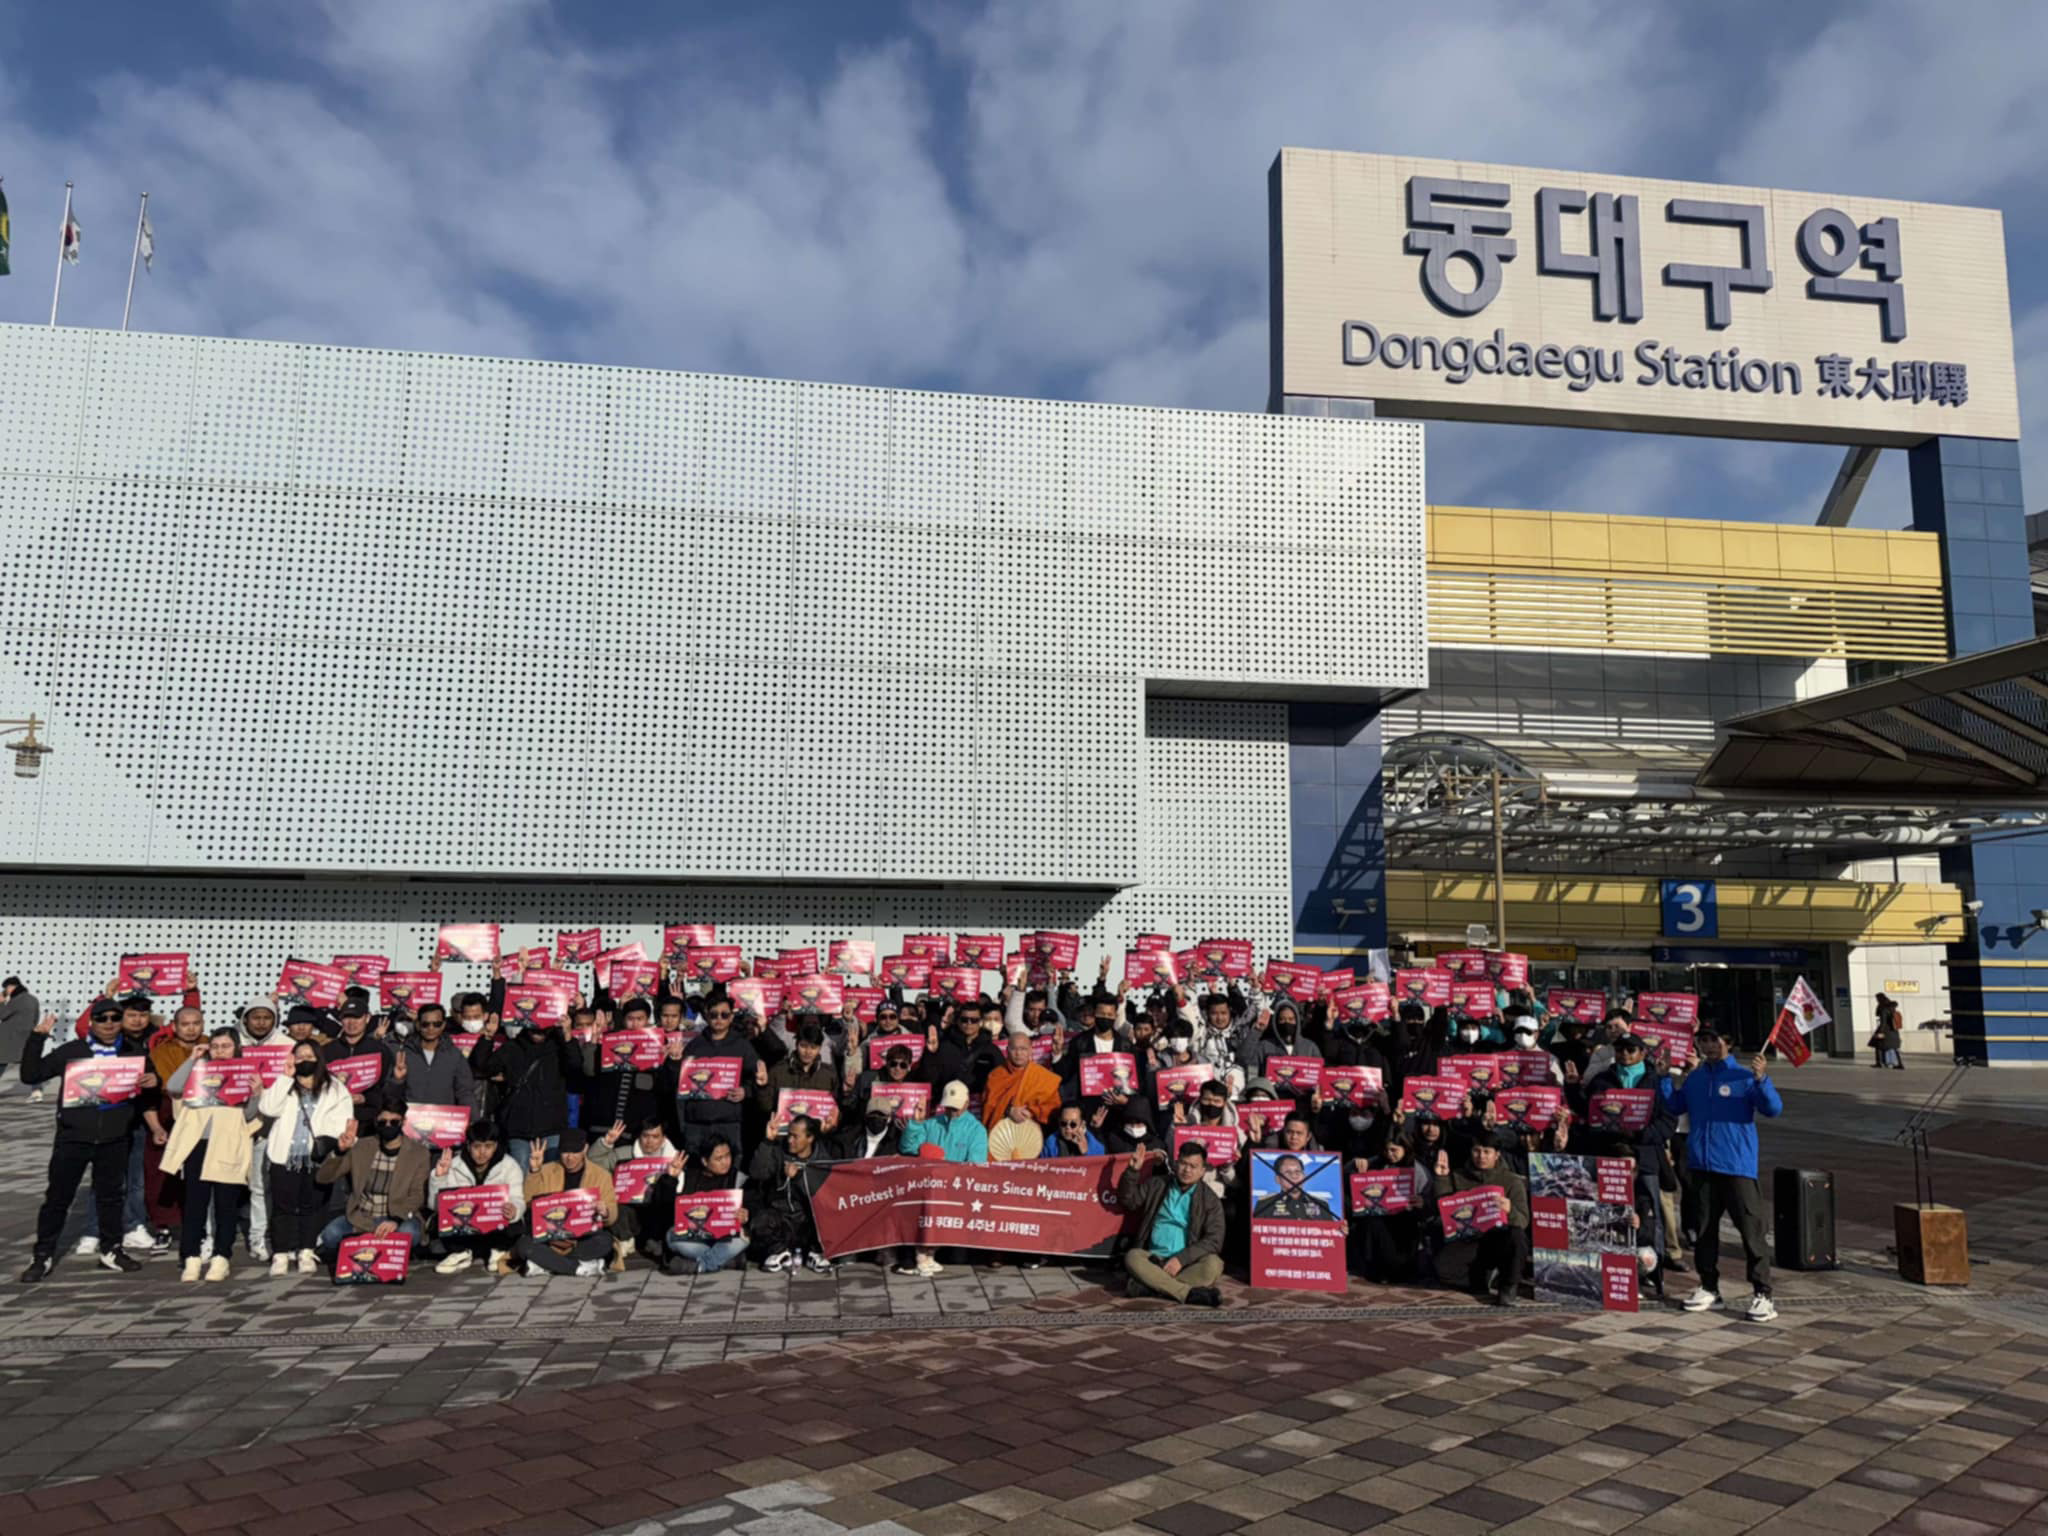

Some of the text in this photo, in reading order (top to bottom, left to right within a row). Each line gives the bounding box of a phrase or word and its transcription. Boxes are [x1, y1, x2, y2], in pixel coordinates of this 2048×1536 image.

[1403, 176, 1908, 343] 동대구역
[1341, 320, 1802, 395] Dongdaegu Station
[1816, 353, 1969, 408] 東大邱驛
[1676, 884, 1704, 932] 3
[838, 1196, 848, 1211] A
[849, 1186, 894, 1208] Protest
[952, 1176, 962, 1191] 4
[966, 1177, 999, 1194] Years
[1002, 1180, 1034, 1197] Since
[1036, 1183, 1099, 1203] Myanmar's
[1102, 1189, 1118, 1205] Co
